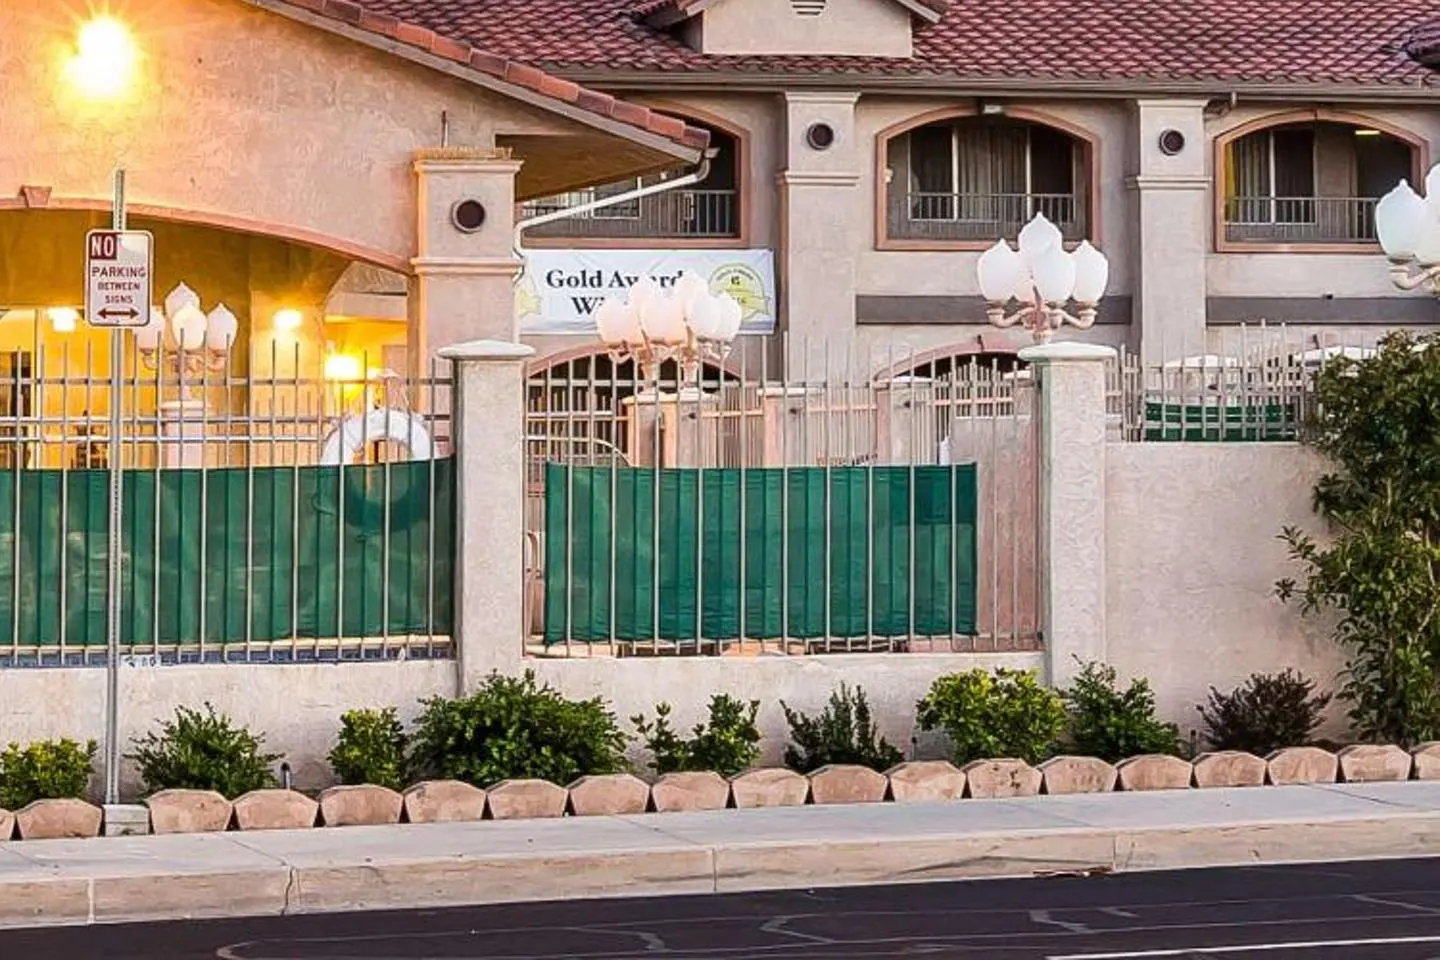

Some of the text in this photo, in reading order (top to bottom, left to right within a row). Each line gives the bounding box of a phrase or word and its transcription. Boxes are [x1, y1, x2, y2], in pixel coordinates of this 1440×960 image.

[91, 235, 114, 257] NO
[92, 266, 146, 277] PARKING
[546, 268, 602, 288] Gold
[98, 282, 140, 291] BETWEEN
[105, 295, 133, 304] SIGNS
